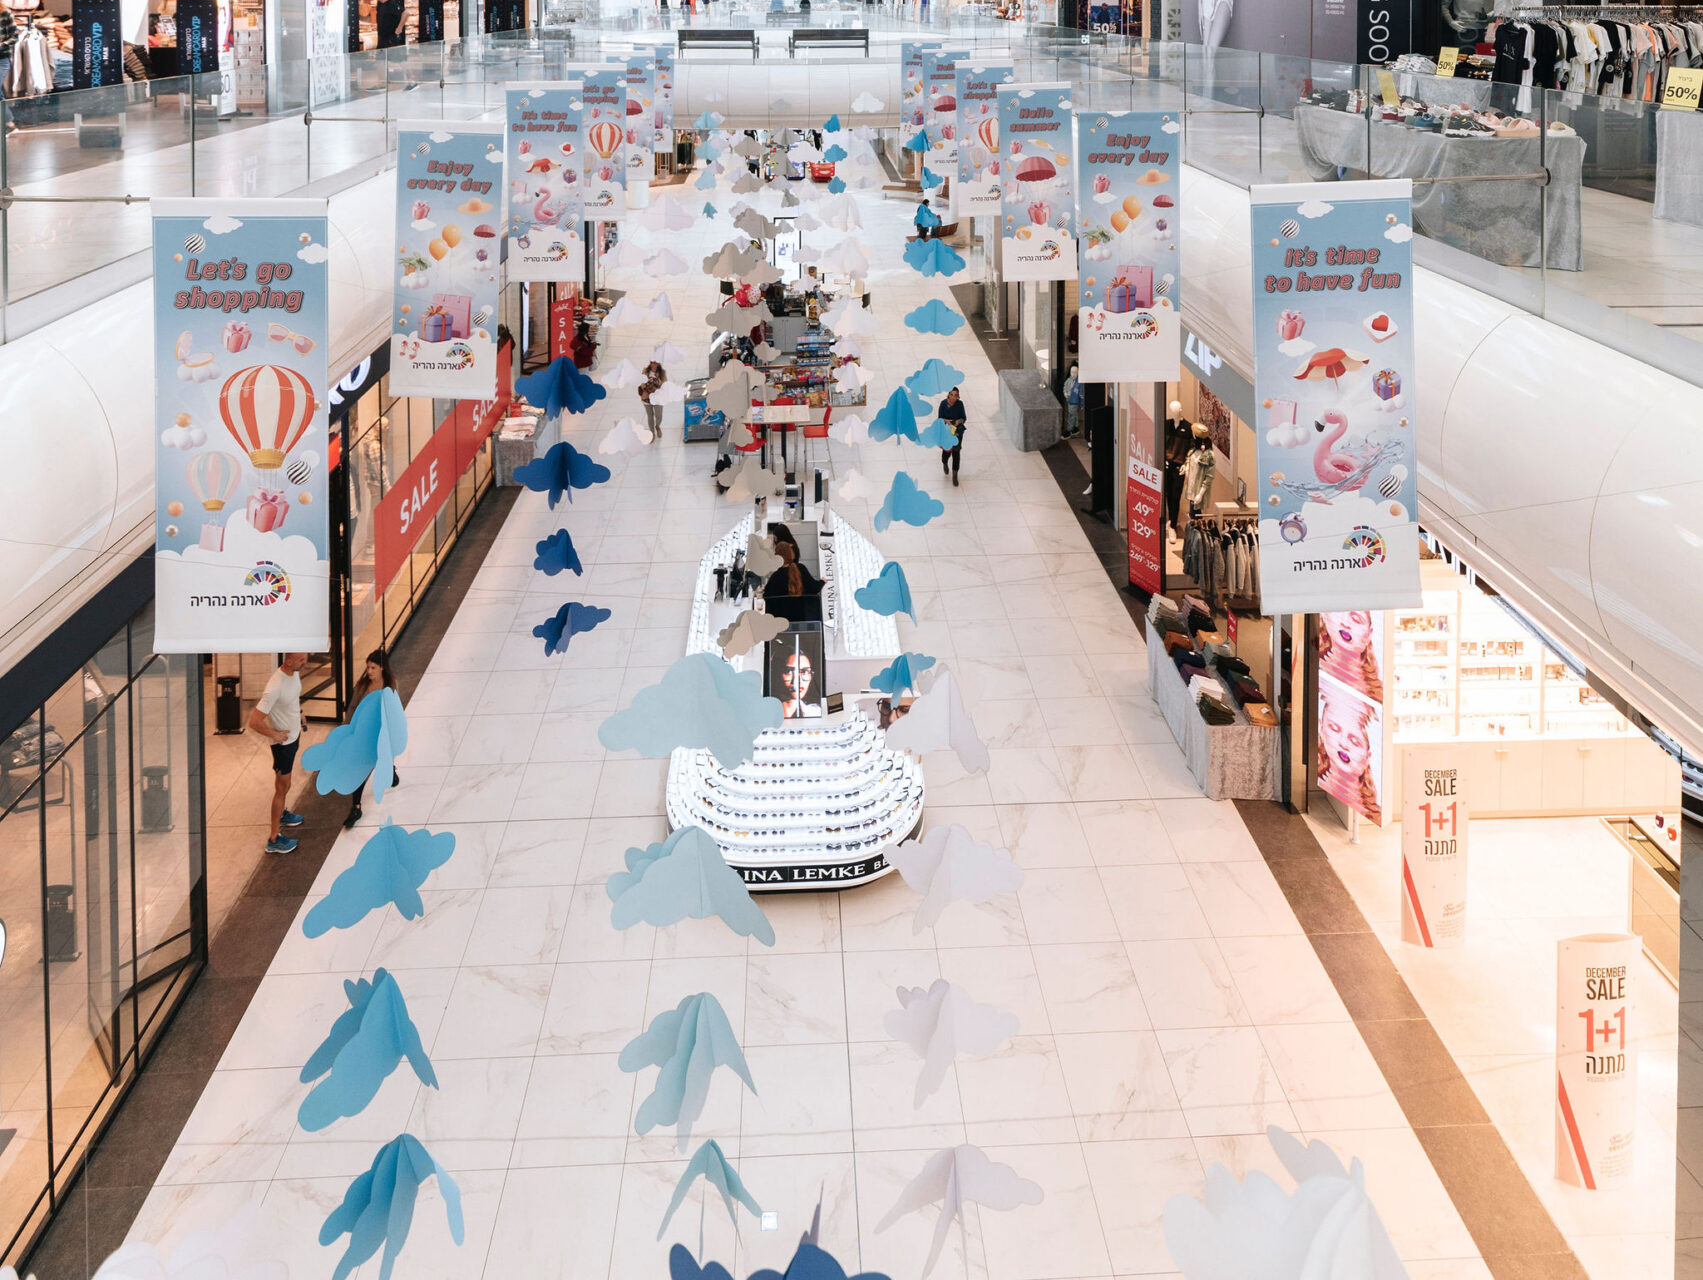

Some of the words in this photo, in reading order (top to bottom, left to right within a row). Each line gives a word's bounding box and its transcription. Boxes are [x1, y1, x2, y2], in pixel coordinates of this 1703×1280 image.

[1369, 10, 1390, 62] SOO
[1438, 61, 1454, 72] 50%
[583, 85, 600, 93] et's
[1666, 86, 1698, 101] 50%
[541, 110, 567, 121] time
[1019, 107, 1053, 119] Hello
[527, 122, 555, 132] have
[557, 122, 577, 134] fun
[1010, 122, 1060, 132] summer
[1106, 134, 1151, 149] Enjoy
[1088, 152, 1135, 166] every
[1138, 150, 1169, 166] day
[427, 159, 474, 177] Enjoy
[407, 177, 456, 193] every
[460, 177, 493, 195] day
[1284, 247, 1317, 267] It's
[1325, 247, 1380, 266] time
[186, 258, 247, 281] Let's
[256, 261, 292, 284] go
[1264, 274, 1292, 293] to
[1296, 271, 1354, 293] have
[1358, 268, 1401, 292] fun
[174, 286, 304, 313] shopping
[558, 317, 567, 354] SAL
[1099, 331, 1120, 341] נהריה
[1123, 331, 1143, 340] ארנה
[1133, 464, 1158, 485] SALE
[400, 458, 439, 534] SALE
[1294, 560, 1327, 572] נהריה
[1331, 558, 1362, 570] ארנה
[190, 594, 225, 607] נהריה
[231, 593, 266, 606] ארנה
[1425, 769, 1457, 779] DECEMBER
[1425, 778, 1457, 797] SALE
[1418, 801, 1457, 838] 1+1
[1425, 839, 1457, 855] מתנה
[741, 870, 783, 882] INA
[793, 863, 866, 881] LEMKE
[1586, 966, 1626, 978] DECEMBER
[1586, 977, 1626, 1001] SALE
[1578, 1006, 1626, 1053] 1+1
[1586, 1053, 1626, 1075] מתנה
